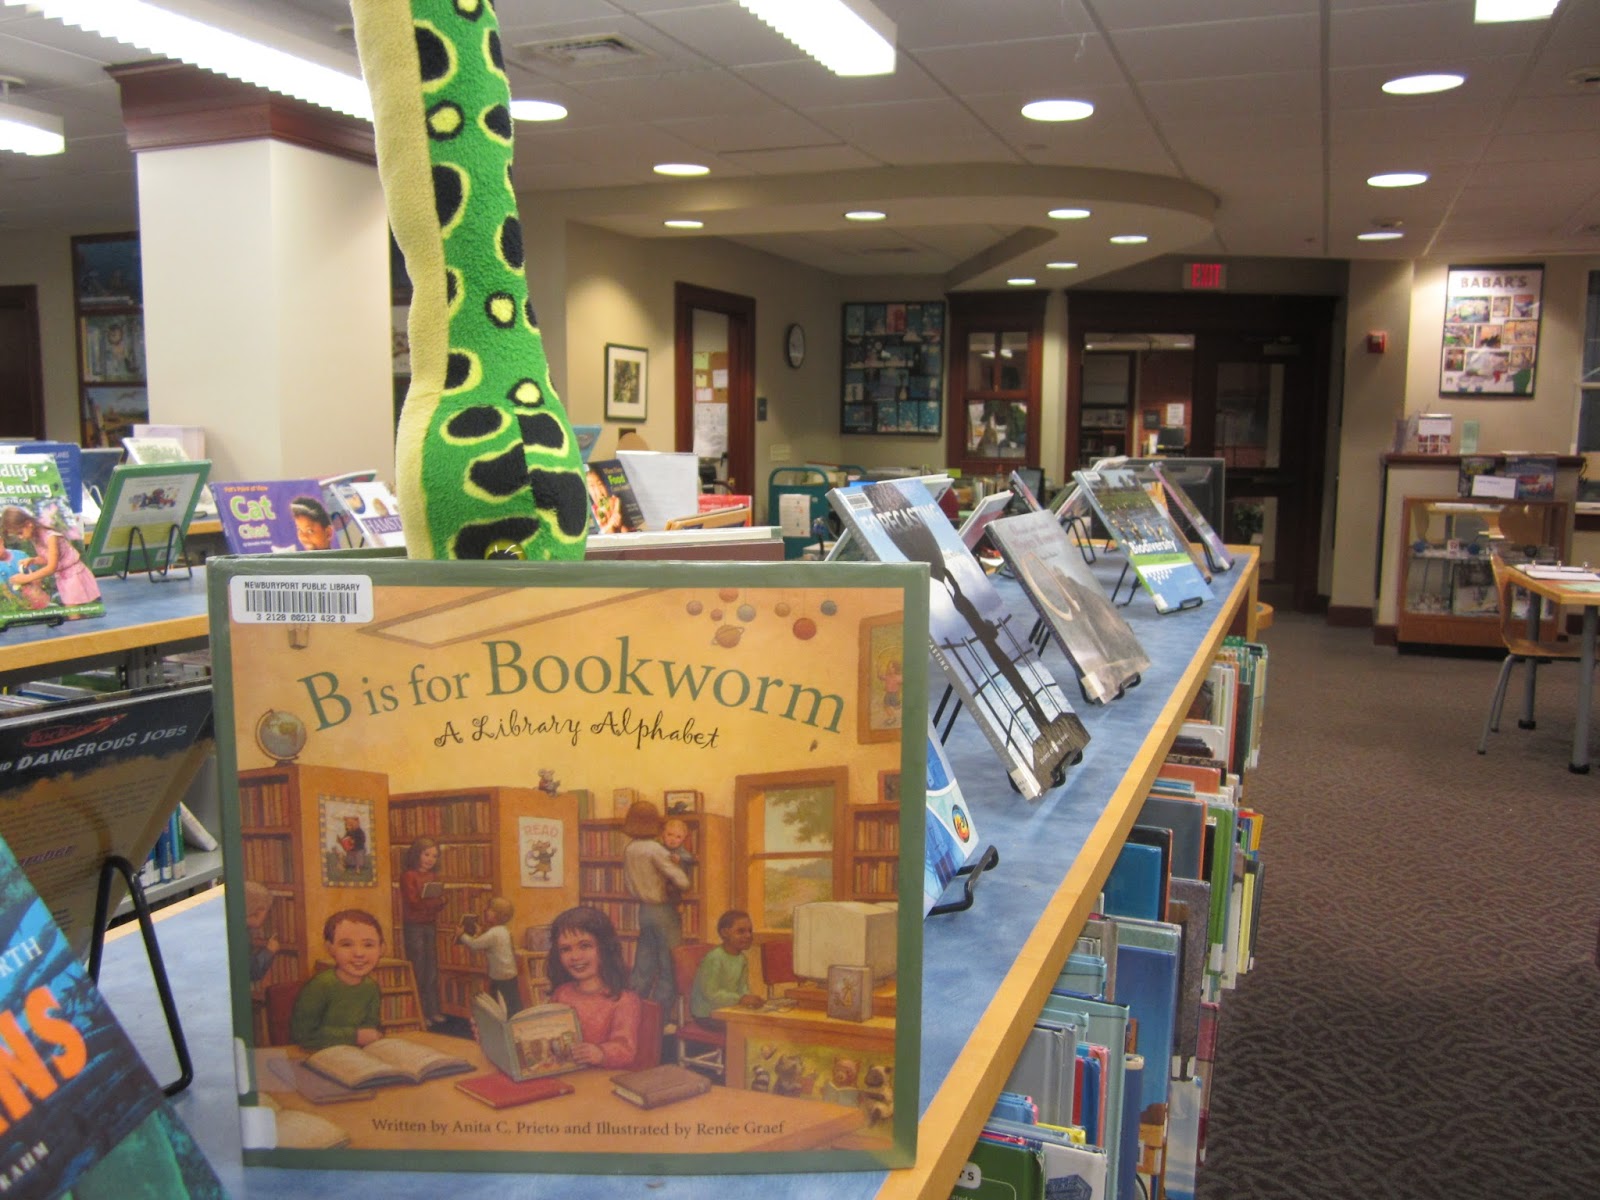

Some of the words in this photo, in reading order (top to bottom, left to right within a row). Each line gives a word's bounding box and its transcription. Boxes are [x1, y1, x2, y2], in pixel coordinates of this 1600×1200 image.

[1191, 263, 1221, 288] EXIT
[1461, 275, 1527, 289] BABAR'S
[230, 495, 276, 521] Cat
[238, 523, 271, 539] Chat
[1127, 539, 1177, 554] Biodiversity
[244, 581, 299, 589] NEWBURYPORT
[302, 582, 327, 590] PUBLIC
[330, 583, 360, 591] LIBRARY
[297, 671, 352, 732] B
[362, 677, 399, 716] is
[408, 664, 470, 706] for
[482, 635, 845, 734] Bookworm
[434, 721, 463, 747] A
[471, 709, 582, 746] Library
[590, 707, 719, 750] Alphabet
[16, 733, 137, 771] DANGEROUS
[140, 725, 188, 744] JOBS
[523, 823, 559, 838] READ
[372, 1117, 427, 1133] Written
[430, 1119, 448, 1136] by
[452, 1119, 491, 1134] Anita
[516, 1120, 560, 1135] Prieto
[564, 1121, 591, 1135] and
[596, 1121, 669, 1136] Illustrated
[674, 1121, 692, 1139] by
[696, 1121, 740, 1136] Renée
[744, 1120, 786, 1136] Graef
